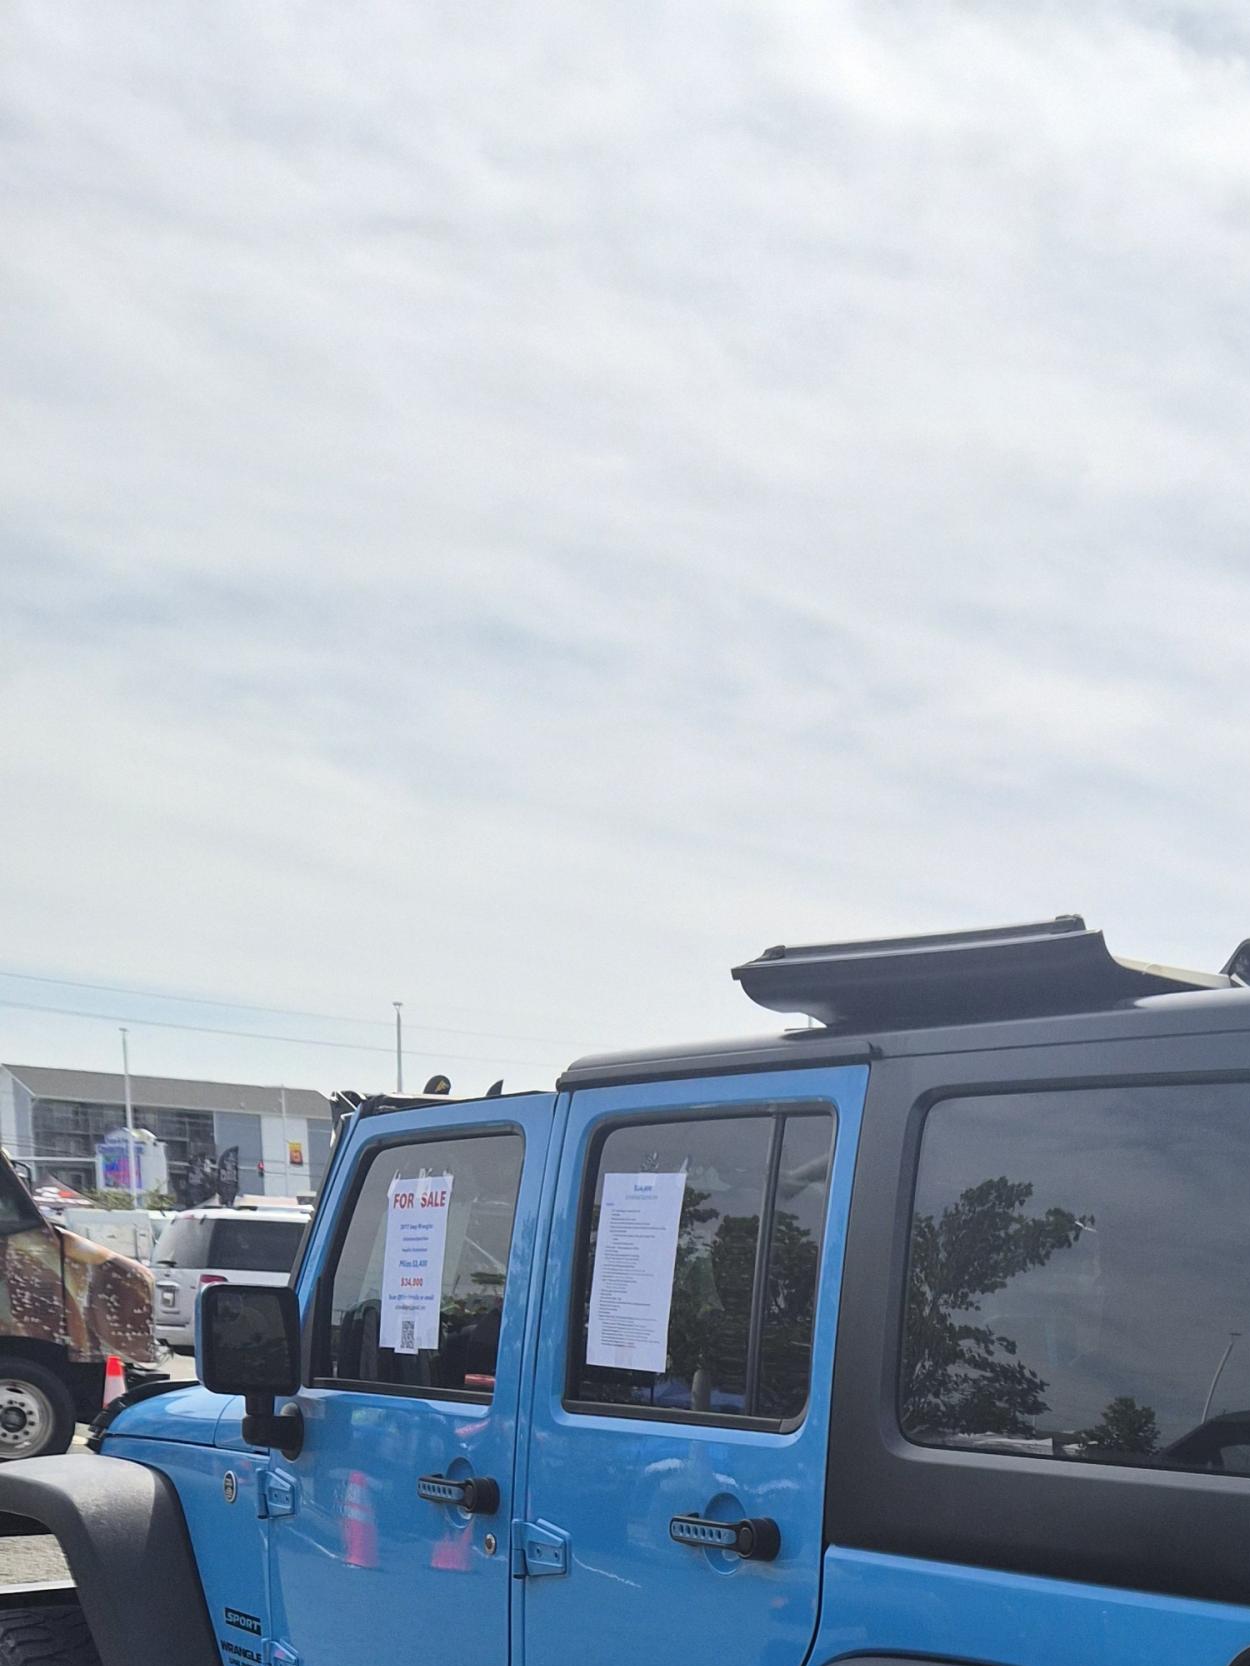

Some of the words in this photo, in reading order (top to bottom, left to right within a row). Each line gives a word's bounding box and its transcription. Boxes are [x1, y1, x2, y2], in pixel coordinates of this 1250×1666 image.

[393, 1193, 414, 1209] FOR
[420, 1190, 447, 1208] SALE
[226, 1612, 260, 1631] SPORT
[221, 1640, 262, 1664] WRANGLE
